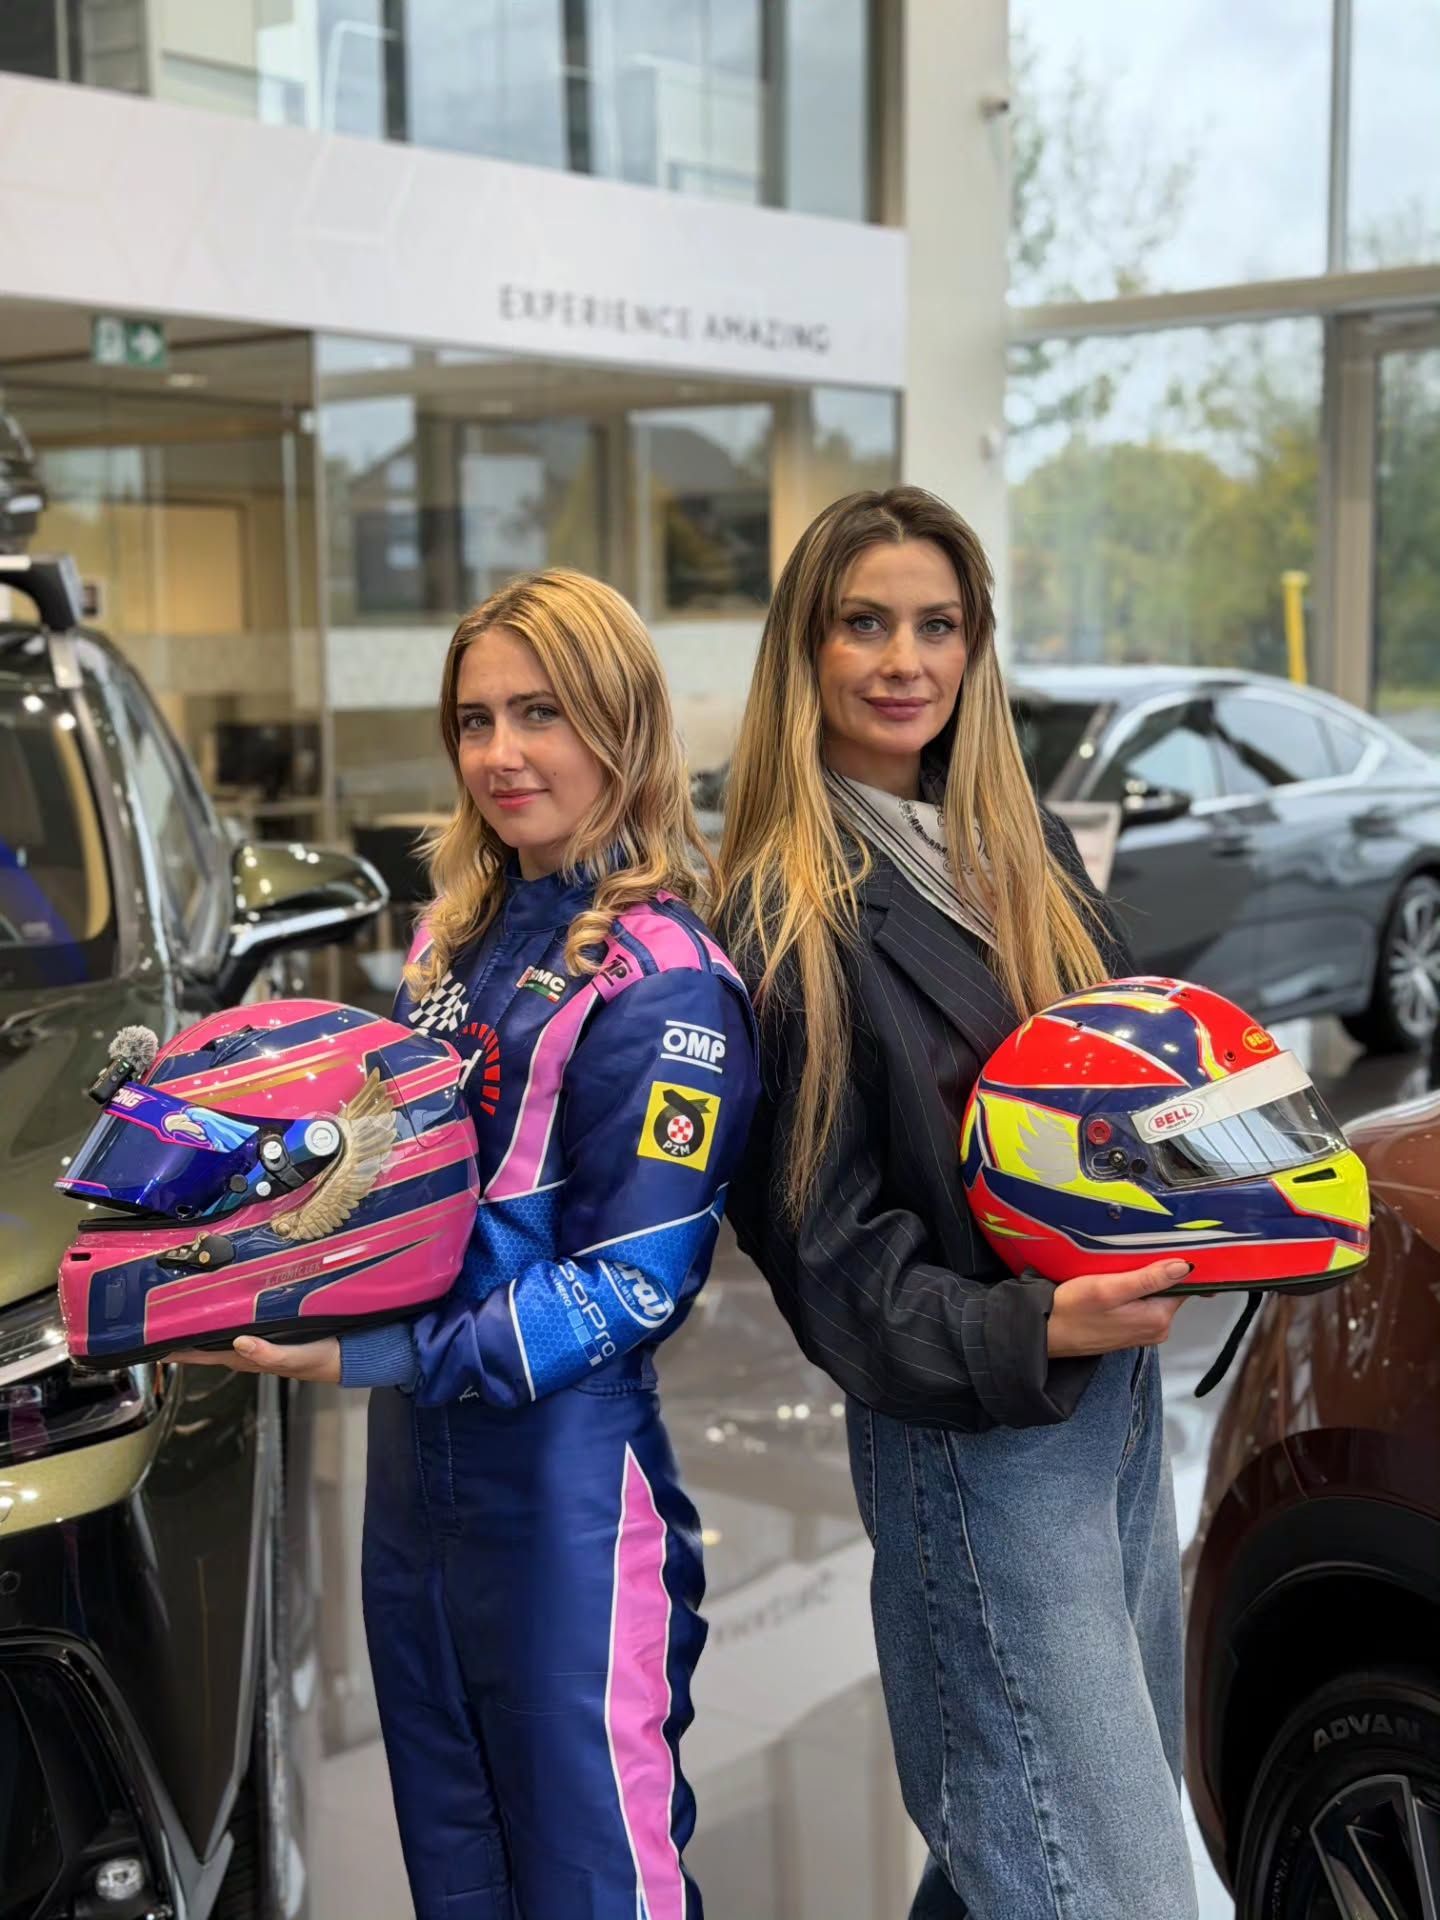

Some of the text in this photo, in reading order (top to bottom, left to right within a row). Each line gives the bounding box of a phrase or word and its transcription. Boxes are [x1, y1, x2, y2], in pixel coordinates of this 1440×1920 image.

[499, 284, 831, 354] EXPERIENCE AMAZING
[663, 1027, 726, 1063] OMP
[1154, 1106, 1193, 1129] BELL
[662, 1139, 691, 1156] PZM
[1312, 1713, 1421, 1752] ADVAN
